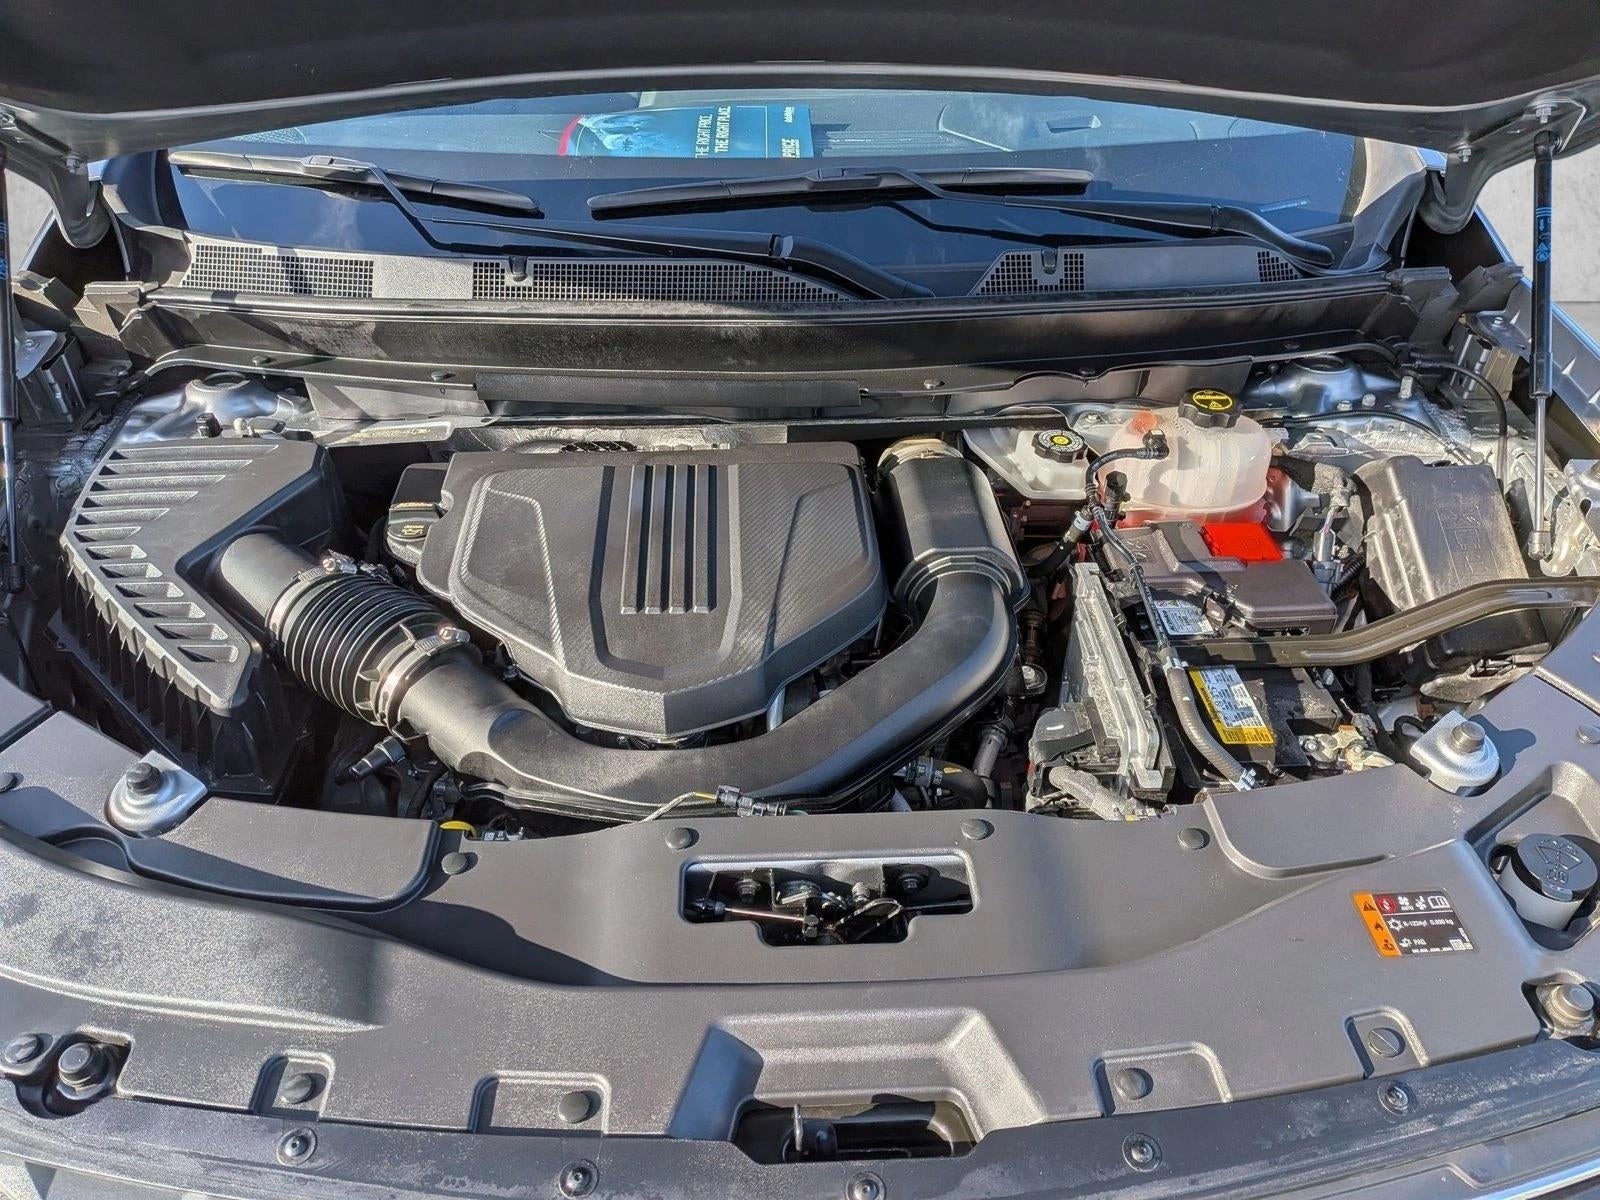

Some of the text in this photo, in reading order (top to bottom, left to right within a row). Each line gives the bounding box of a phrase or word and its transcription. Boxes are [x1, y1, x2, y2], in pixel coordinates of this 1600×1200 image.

[696, 128, 711, 145] RIGHT
[716, 122, 730, 139] RIGHT
[714, 139, 729, 153] THE
